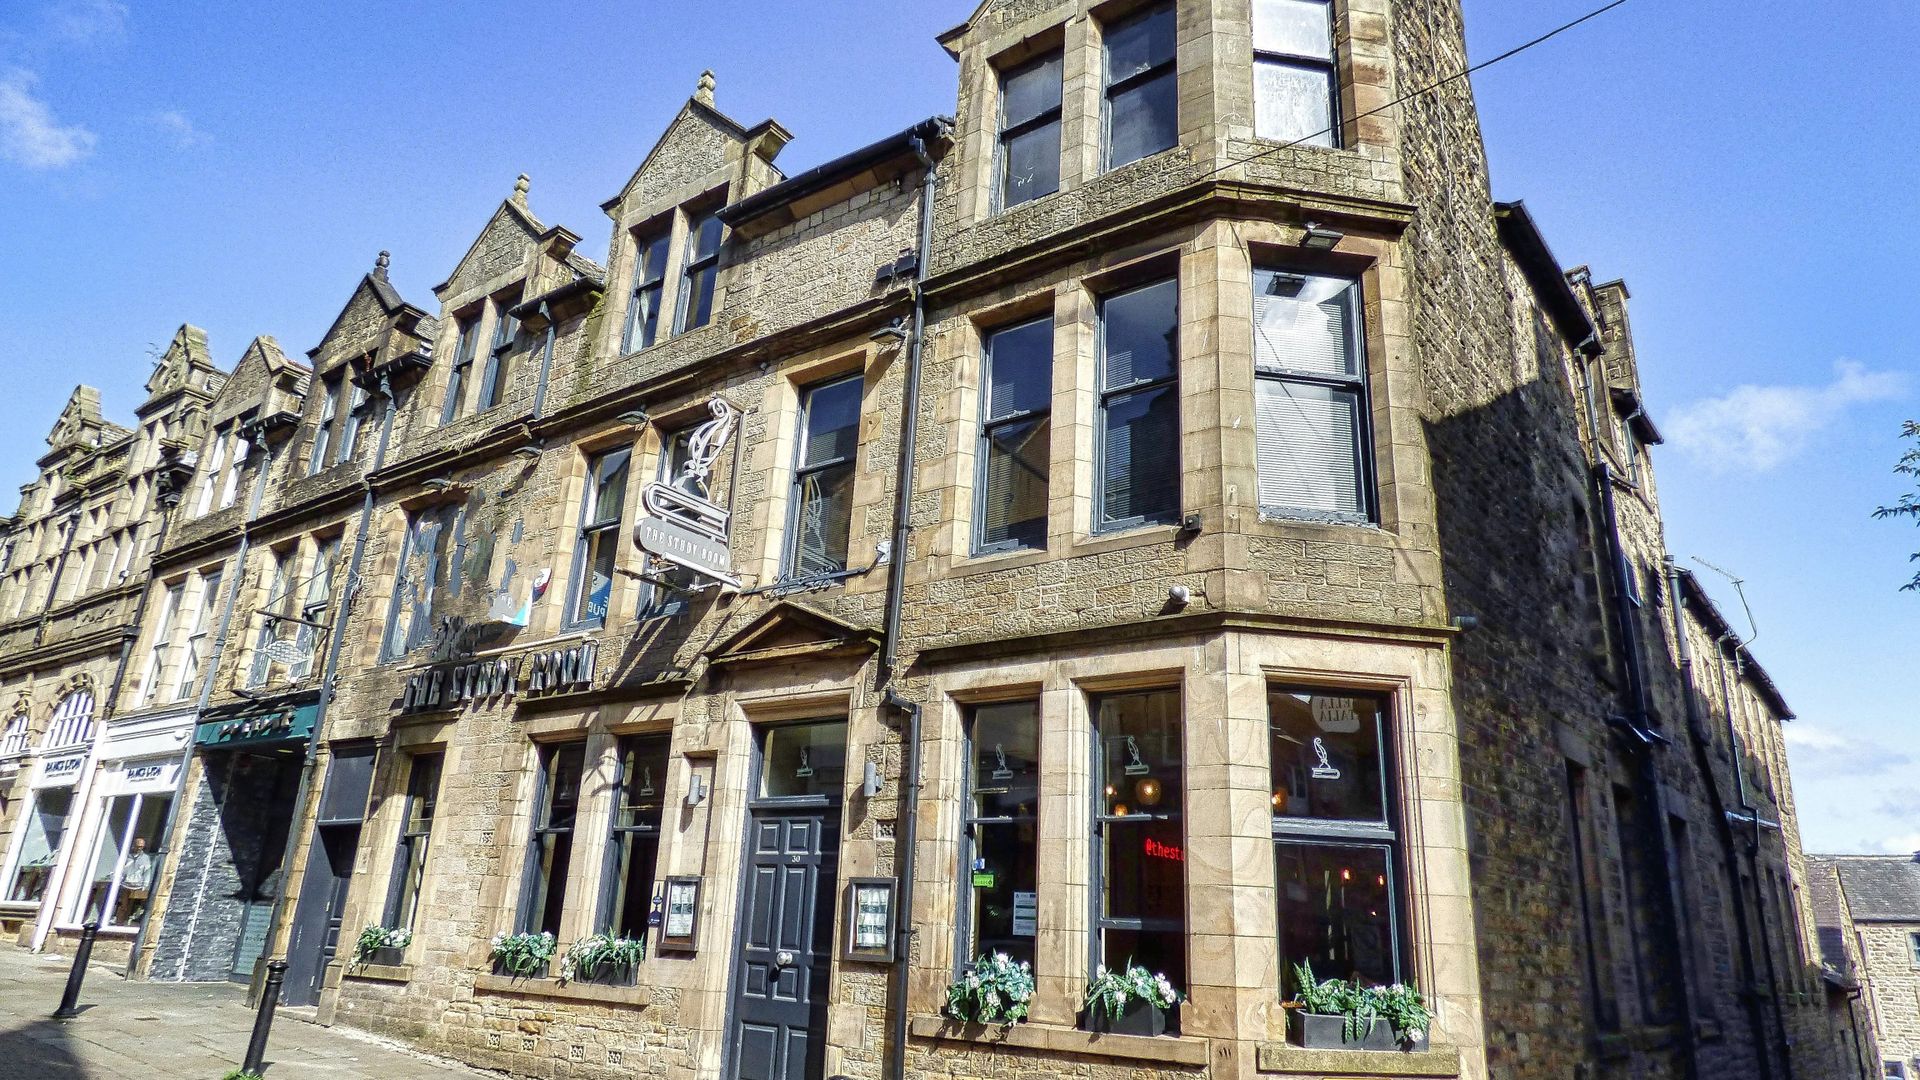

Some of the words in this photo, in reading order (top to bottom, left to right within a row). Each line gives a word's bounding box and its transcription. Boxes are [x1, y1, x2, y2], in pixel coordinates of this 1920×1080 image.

[646, 526, 665, 543] THE
[667, 533, 698, 557] STUDY
[791, 855, 801, 863] 30
